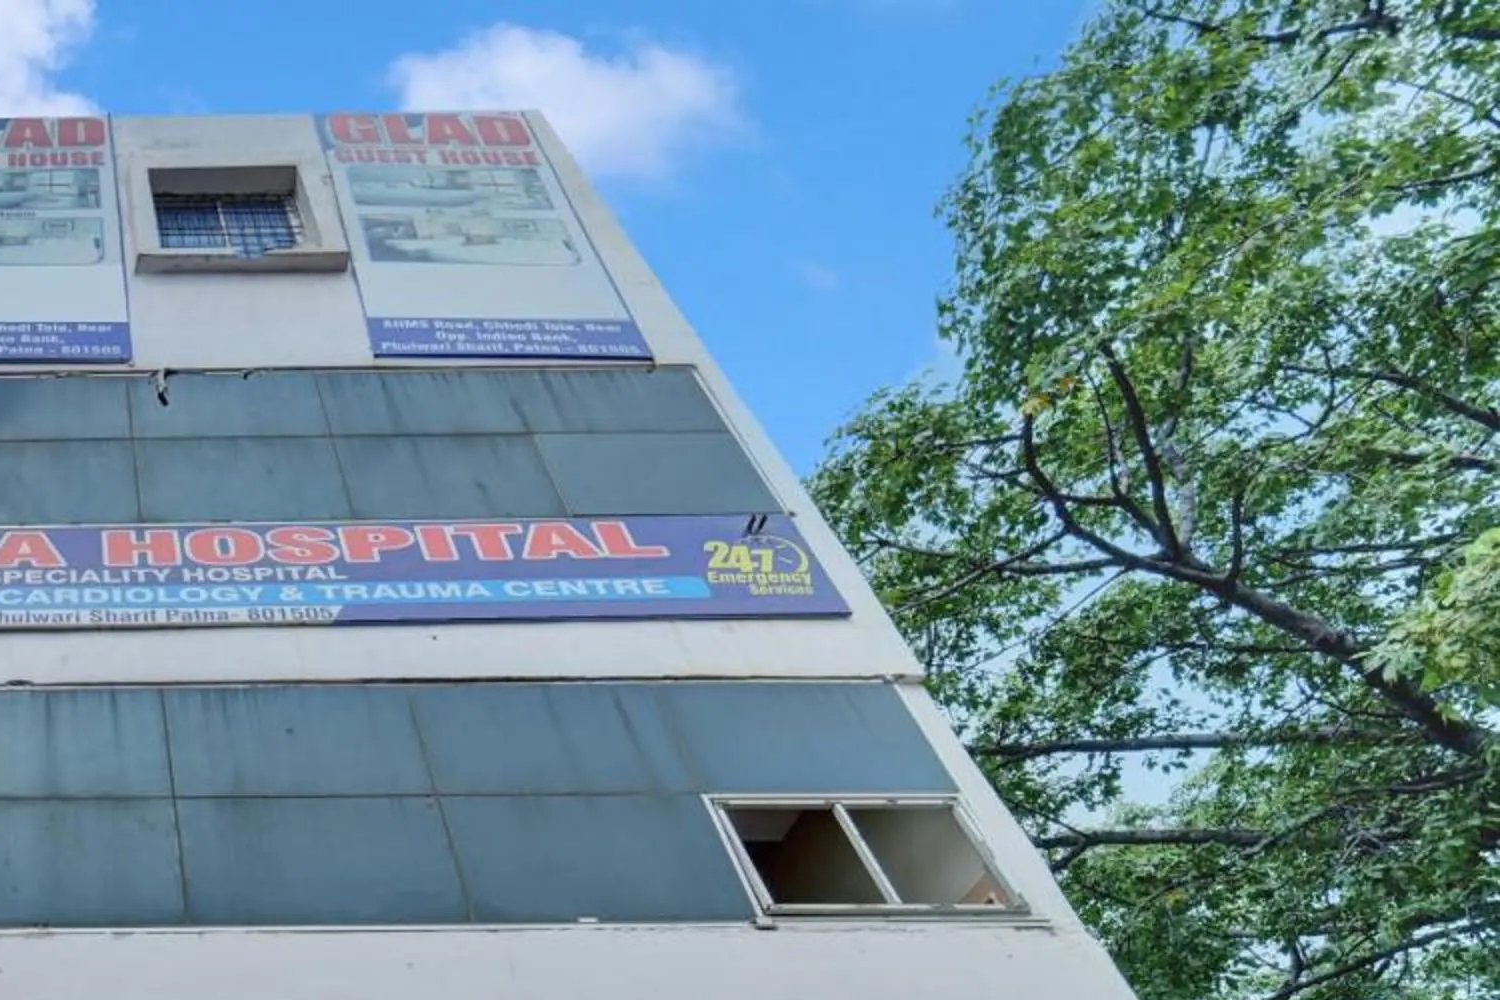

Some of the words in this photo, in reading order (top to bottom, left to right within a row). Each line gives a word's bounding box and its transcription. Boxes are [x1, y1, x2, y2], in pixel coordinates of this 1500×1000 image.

[329, 114, 531, 146] GLAD
[7, 152, 106, 167] HOUSE
[336, 149, 427, 164] GUEST
[438, 149, 541, 165] HOUSE
[0, 345, 43, 354] Patna
[101, 522, 671, 568] HOSPITAL
[182, 565, 348, 582] HOSPITAL
[707, 571, 811, 586] Emergency
[279, 585, 303, 600] &
[314, 583, 491, 600] TRAUMA
[502, 579, 670, 597] CENTRE
[248, 606, 335, 621] 801505
